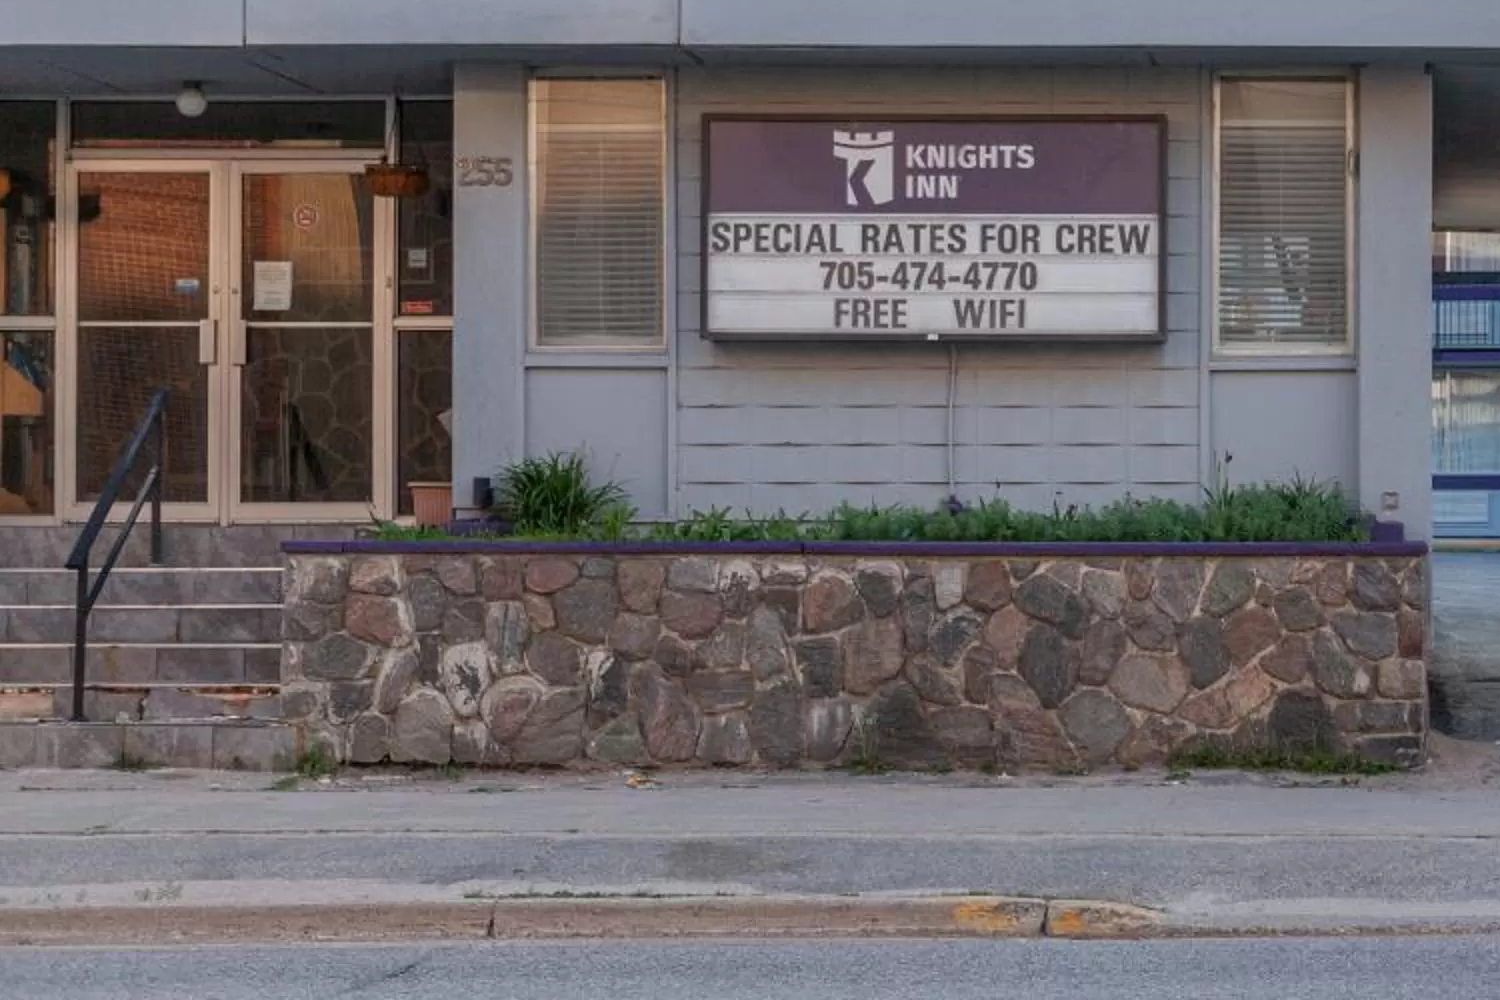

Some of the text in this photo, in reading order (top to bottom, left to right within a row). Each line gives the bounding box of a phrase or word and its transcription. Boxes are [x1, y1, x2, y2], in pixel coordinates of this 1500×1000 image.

[906, 144, 1035, 168] KNIGHTS
[906, 175, 958, 199] INN
[711, 222, 1150, 254] SPECIAL RATES FOR CREW
[820, 261, 1037, 291] 705-474-4770
[834, 298, 1026, 329] FREE WIFI
